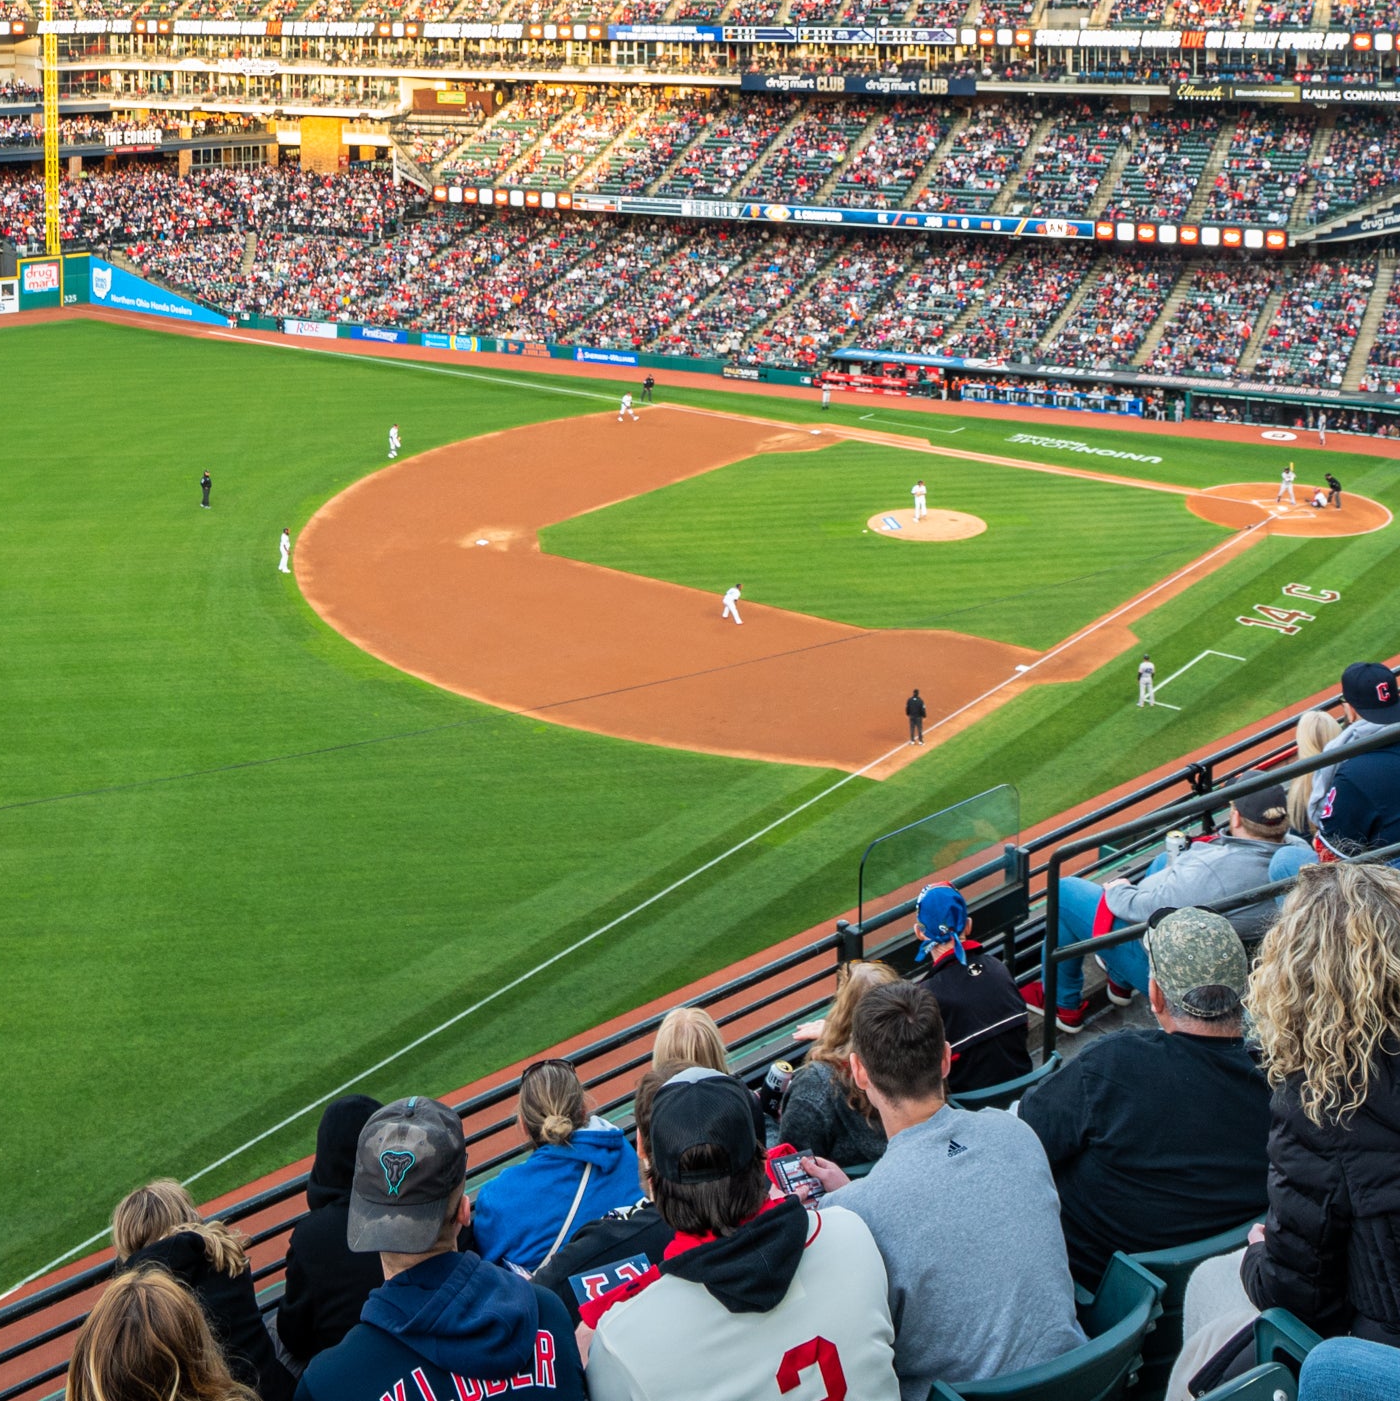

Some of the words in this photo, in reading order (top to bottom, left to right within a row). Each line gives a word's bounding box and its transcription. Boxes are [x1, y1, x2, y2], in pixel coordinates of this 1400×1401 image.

[1181, 31, 1206, 49] LIVE
[765, 78, 790, 91] drug
[790, 78, 815, 89] mart
[816, 76, 845, 92] CLUB
[865, 79, 890, 93] drug
[890, 80, 917, 91] mart
[918, 78, 949, 95] CLUB
[1302, 89, 1342, 101] KAULIG
[104, 130, 123, 147] THE
[124, 128, 163, 146] CORNER
[1360, 217, 1385, 231] drug
[25, 267, 53, 281] drug
[28, 275, 59, 290] mart
[63, 294, 77, 303] 325
[111, 293, 136, 307] Northern
[136, 298, 150, 309] Ohio
[150, 301, 170, 312] Honda
[170, 303, 193, 316] Dealers
[296, 321, 320, 334] ROSE
[1235, 603, 1317, 636] 14
[1376, 682, 1391, 702] C
